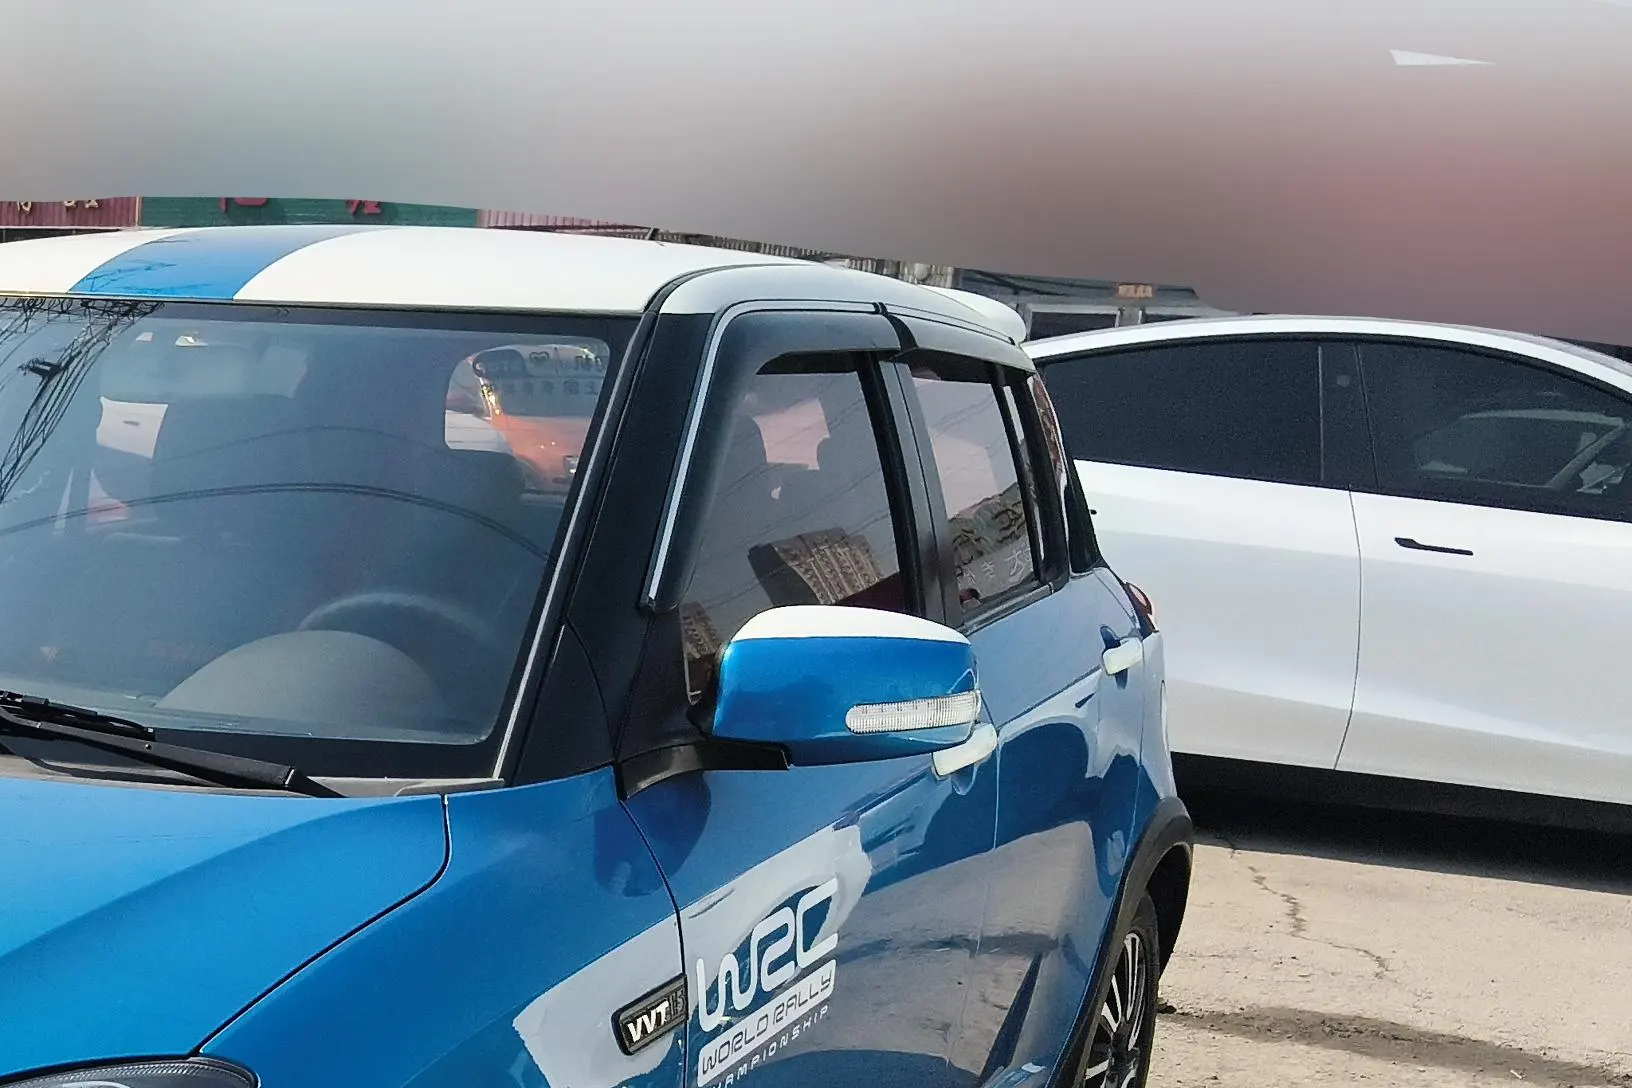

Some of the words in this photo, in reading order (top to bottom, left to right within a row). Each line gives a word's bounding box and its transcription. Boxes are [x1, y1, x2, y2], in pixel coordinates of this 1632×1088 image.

[696, 877, 838, 1032] WRC
[702, 1000, 770, 1075] WORLD
[771, 969, 832, 1026] RALLY
